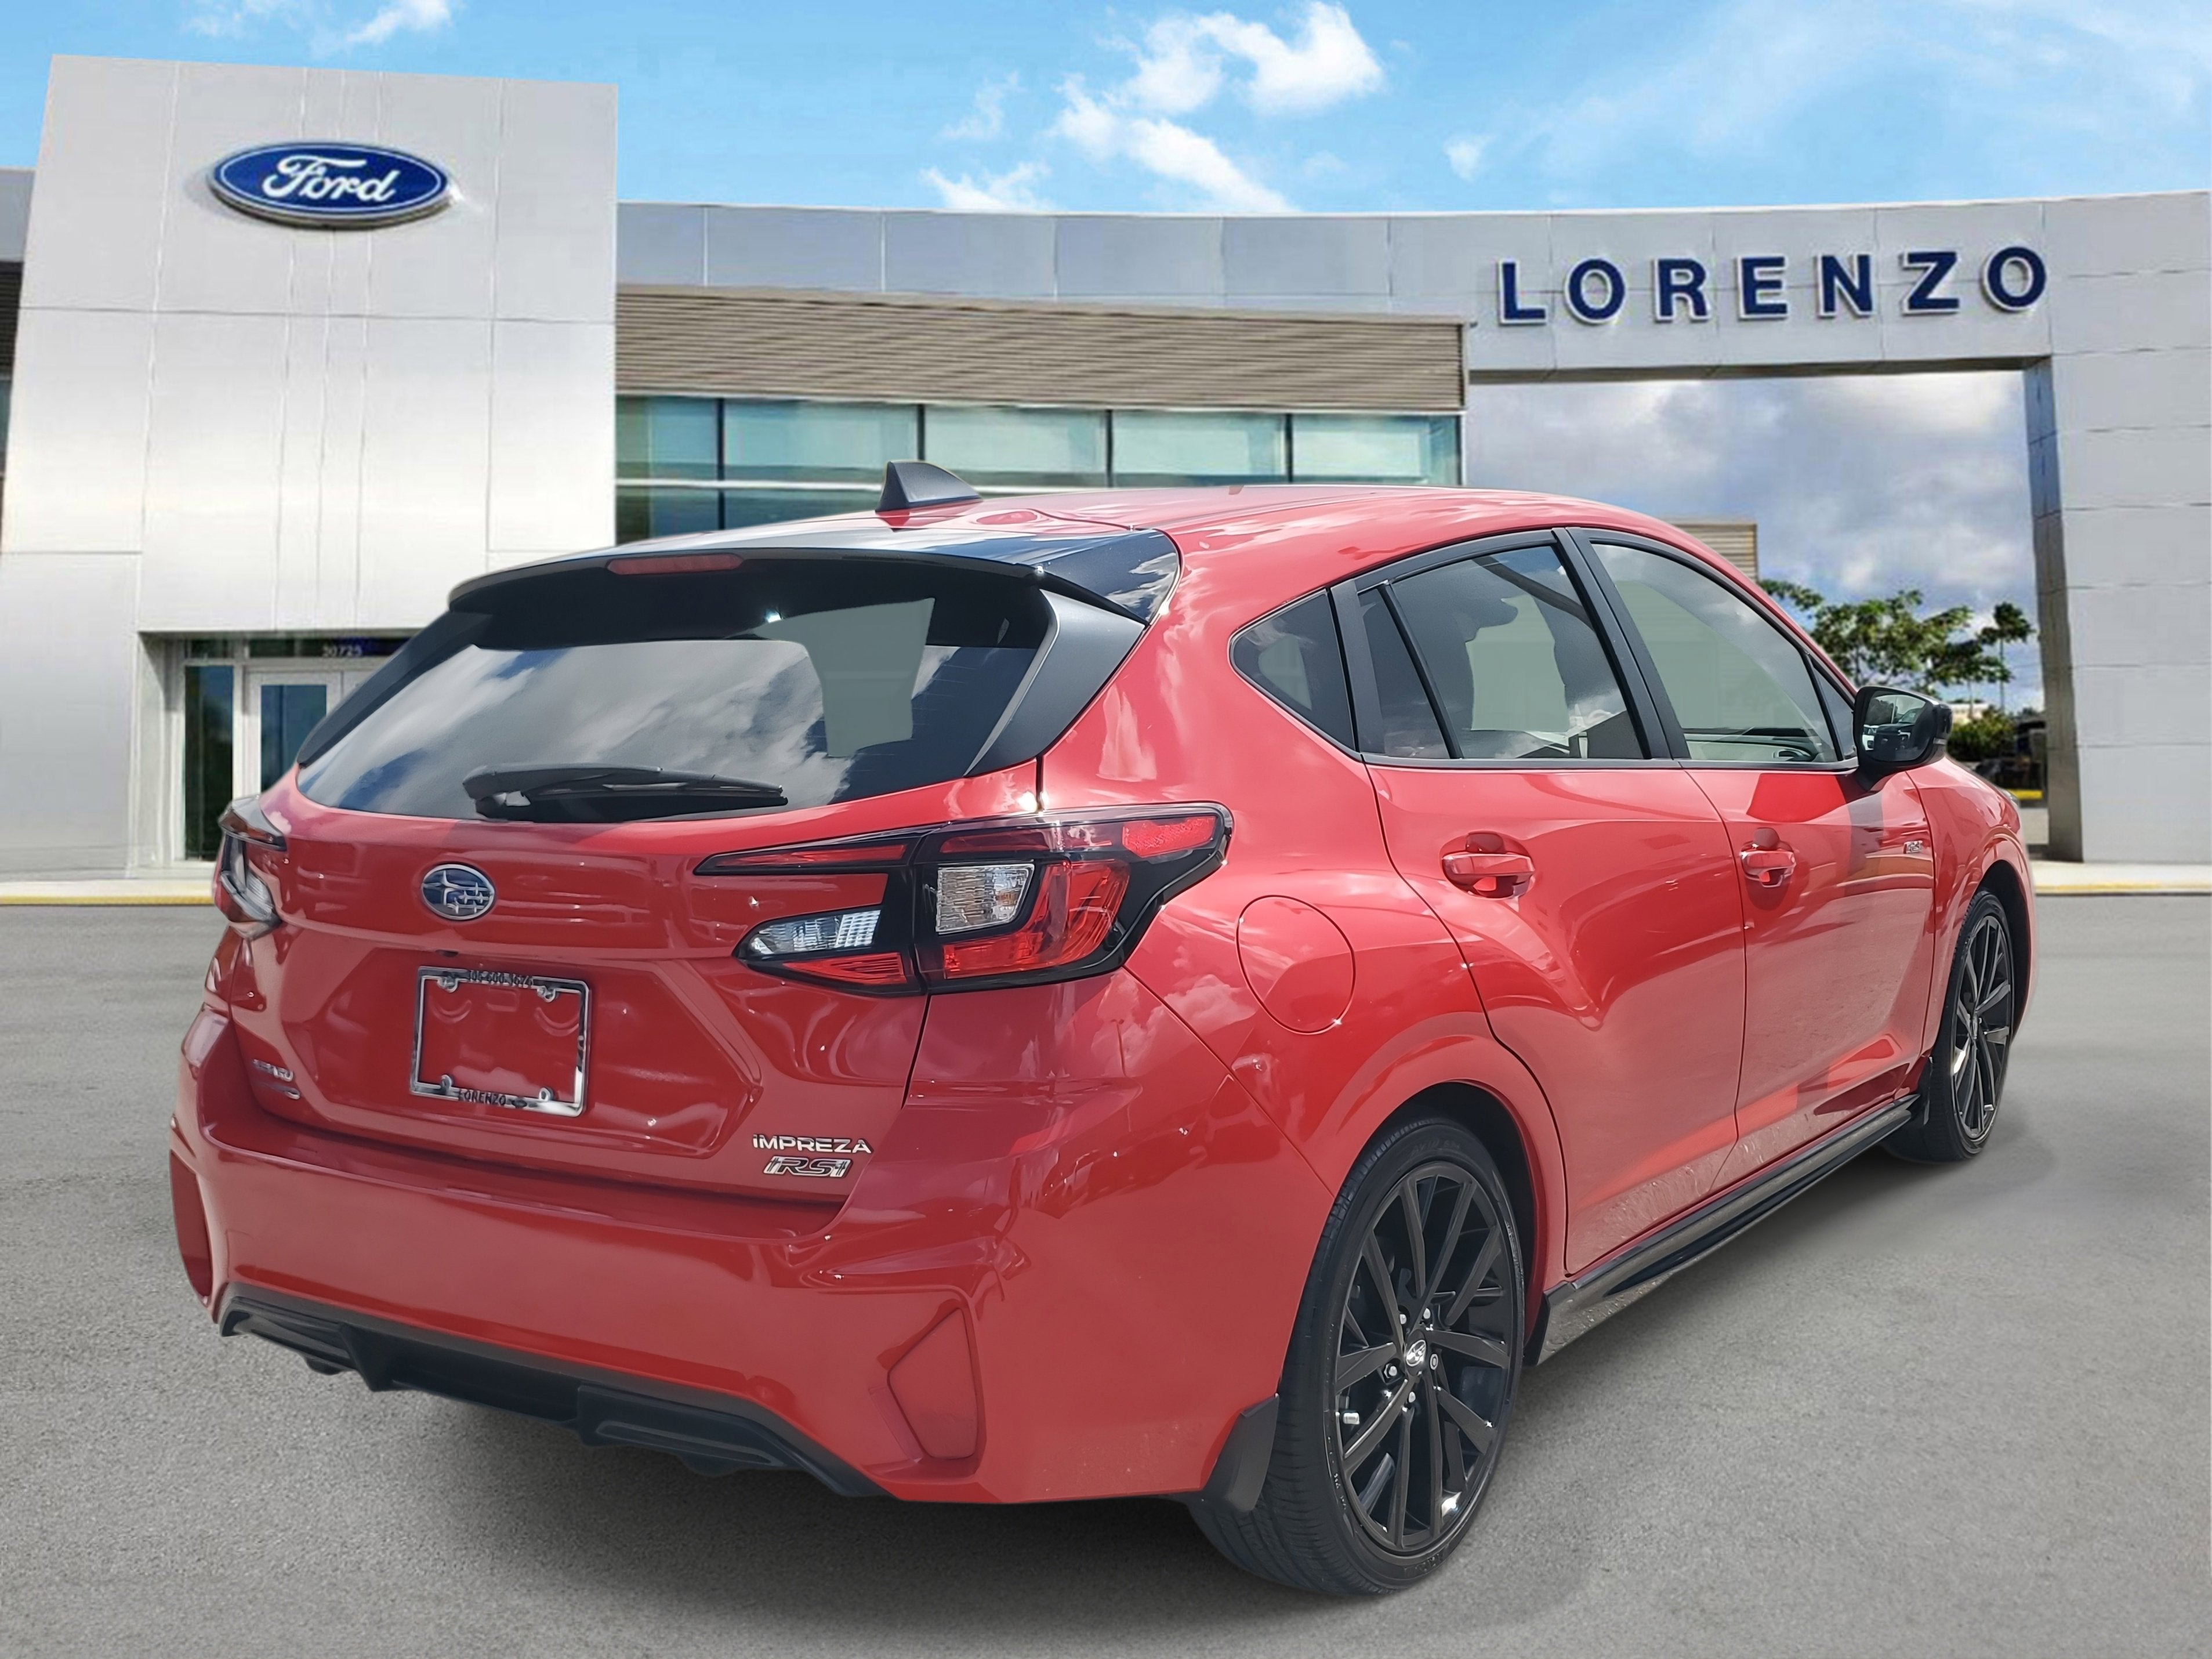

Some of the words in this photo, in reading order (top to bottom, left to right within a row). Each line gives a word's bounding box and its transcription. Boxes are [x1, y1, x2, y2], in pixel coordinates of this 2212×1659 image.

[262, 154, 401, 202] Ford
[1499, 246, 2048, 325] LORENZO
[753, 1134, 872, 1154] IMPREZA
